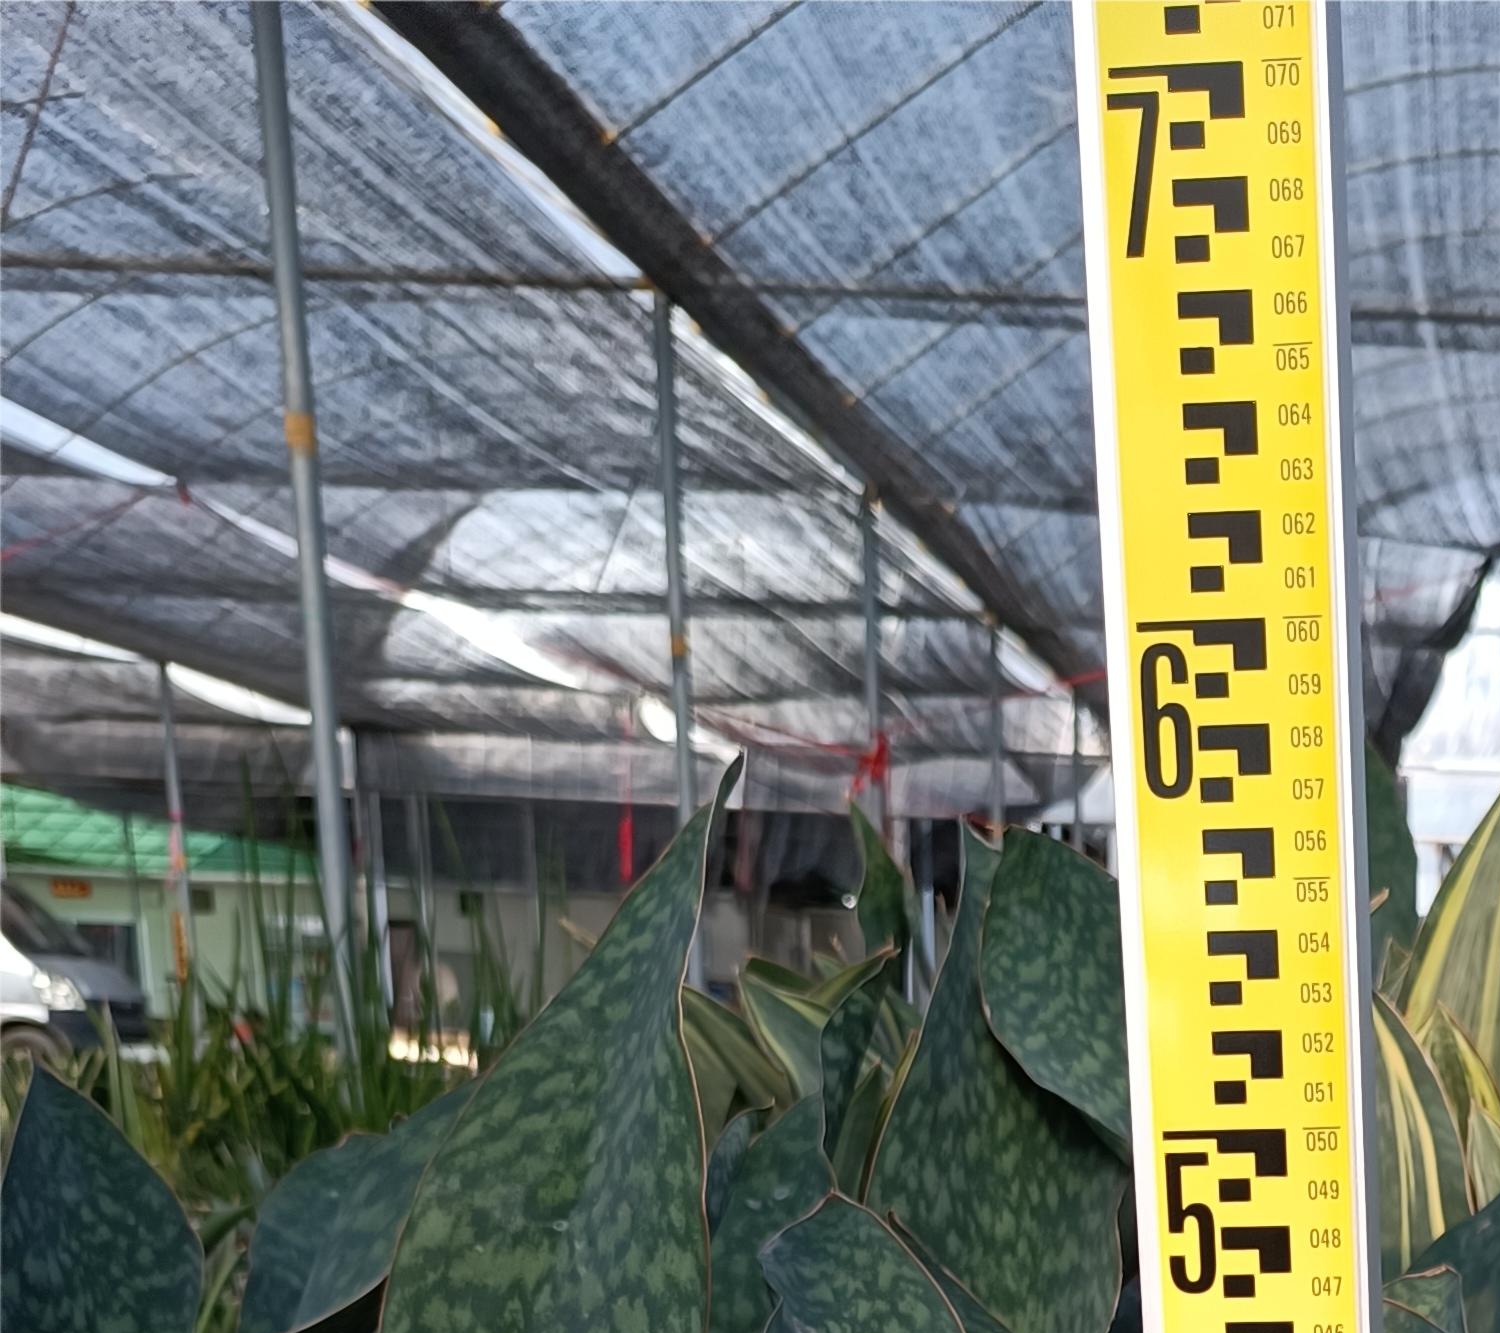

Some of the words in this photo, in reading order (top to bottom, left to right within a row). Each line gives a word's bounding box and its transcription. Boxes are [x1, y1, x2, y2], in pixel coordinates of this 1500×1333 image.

[1262, 4, 1295, 30] 071
[1264, 62, 1300, 88] 070
[1267, 120, 1302, 145] 069
[1107, 92, 1159, 258] 7
[1269, 177, 1304, 202] 068
[1271, 234, 1305, 259] 067
[1273, 290, 1308, 316] 066
[1275, 346, 1310, 372] 065
[1277, 402, 1312, 427] 064
[1280, 457, 1314, 482] 063
[1282, 511, 1316, 536] 062
[1284, 565, 1315, 589] 061
[1286, 619, 1320, 643] 060
[1288, 673, 1322, 696] 059
[1141, 643, 1192, 798] 6
[1290, 725, 1324, 749] 058
[1292, 777, 1325, 801] 057
[1294, 829, 1327, 852] 056
[1296, 880, 1329, 903] 055
[1298, 931, 1330, 954] 054
[1300, 982, 1333, 1004] 053
[1301, 1031, 1335, 1054] 052
[1303, 1081, 1334, 1103] 051
[1305, 1130, 1338, 1152] 050
[1307, 1179, 1340, 1201] 049
[1166, 1153, 1216, 1294] 5
[1309, 1227, 1342, 1249] 048
[1311, 1275, 1343, 1297] 047
